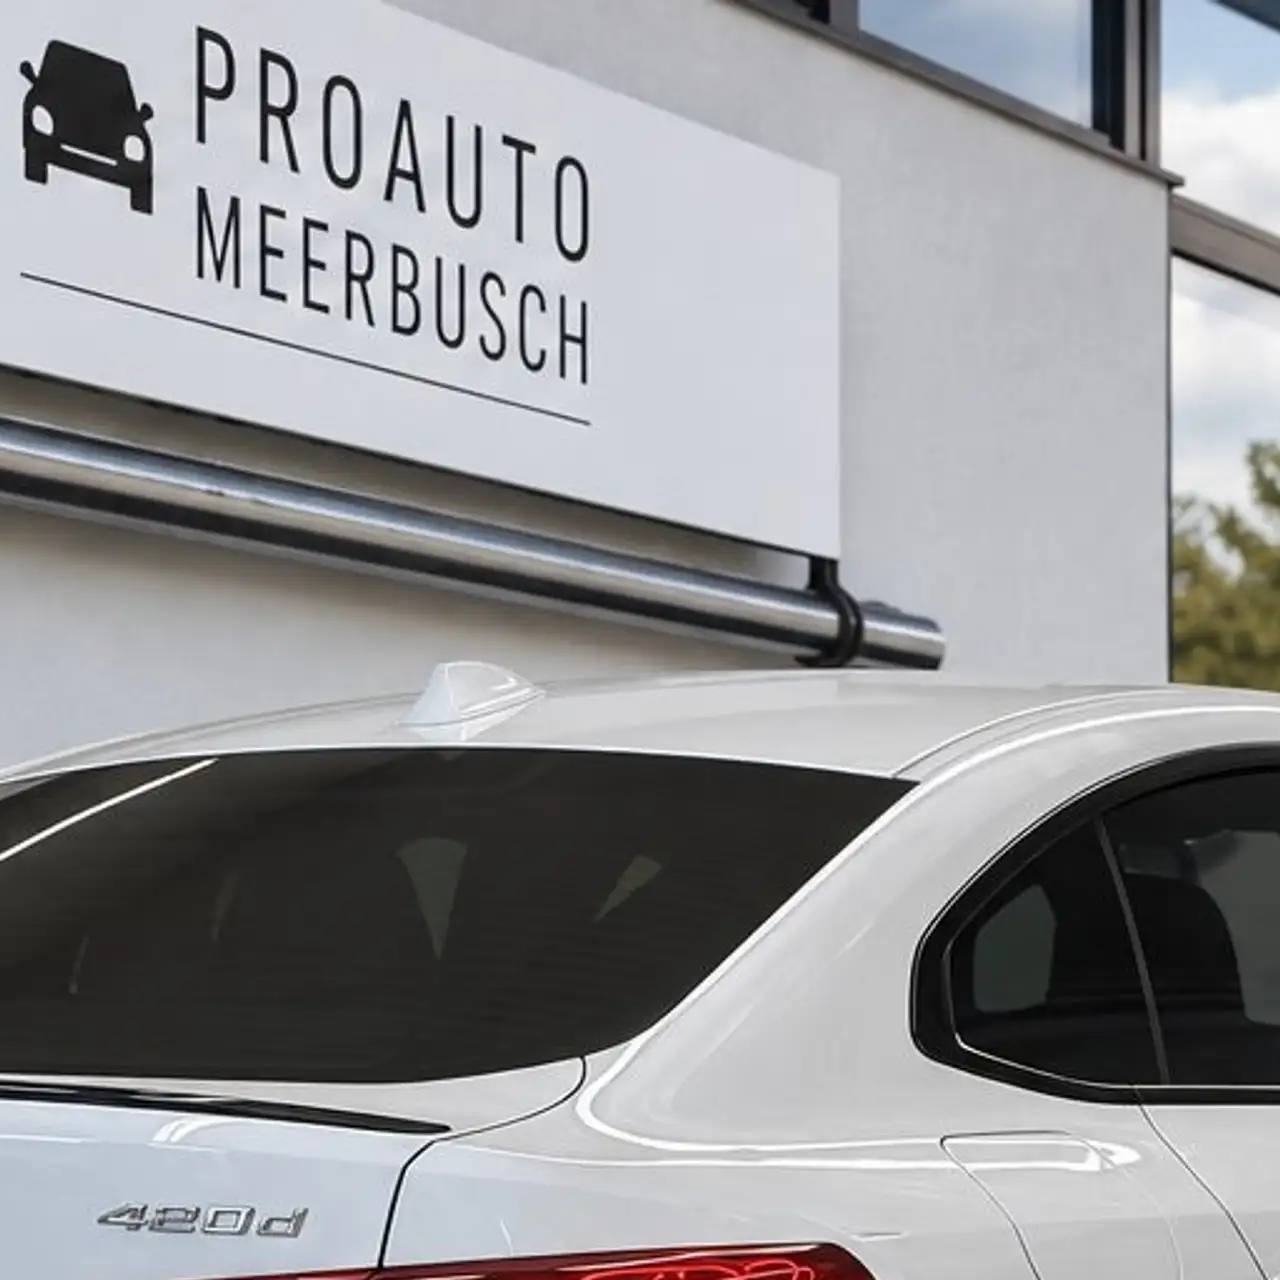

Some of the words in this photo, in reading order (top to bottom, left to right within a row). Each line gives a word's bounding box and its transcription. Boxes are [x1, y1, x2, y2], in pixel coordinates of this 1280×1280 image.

[196, 25, 589, 262] PROAUTO
[196, 185, 587, 385] MEERBUSCH
[97, 1203, 308, 1238] 420d
